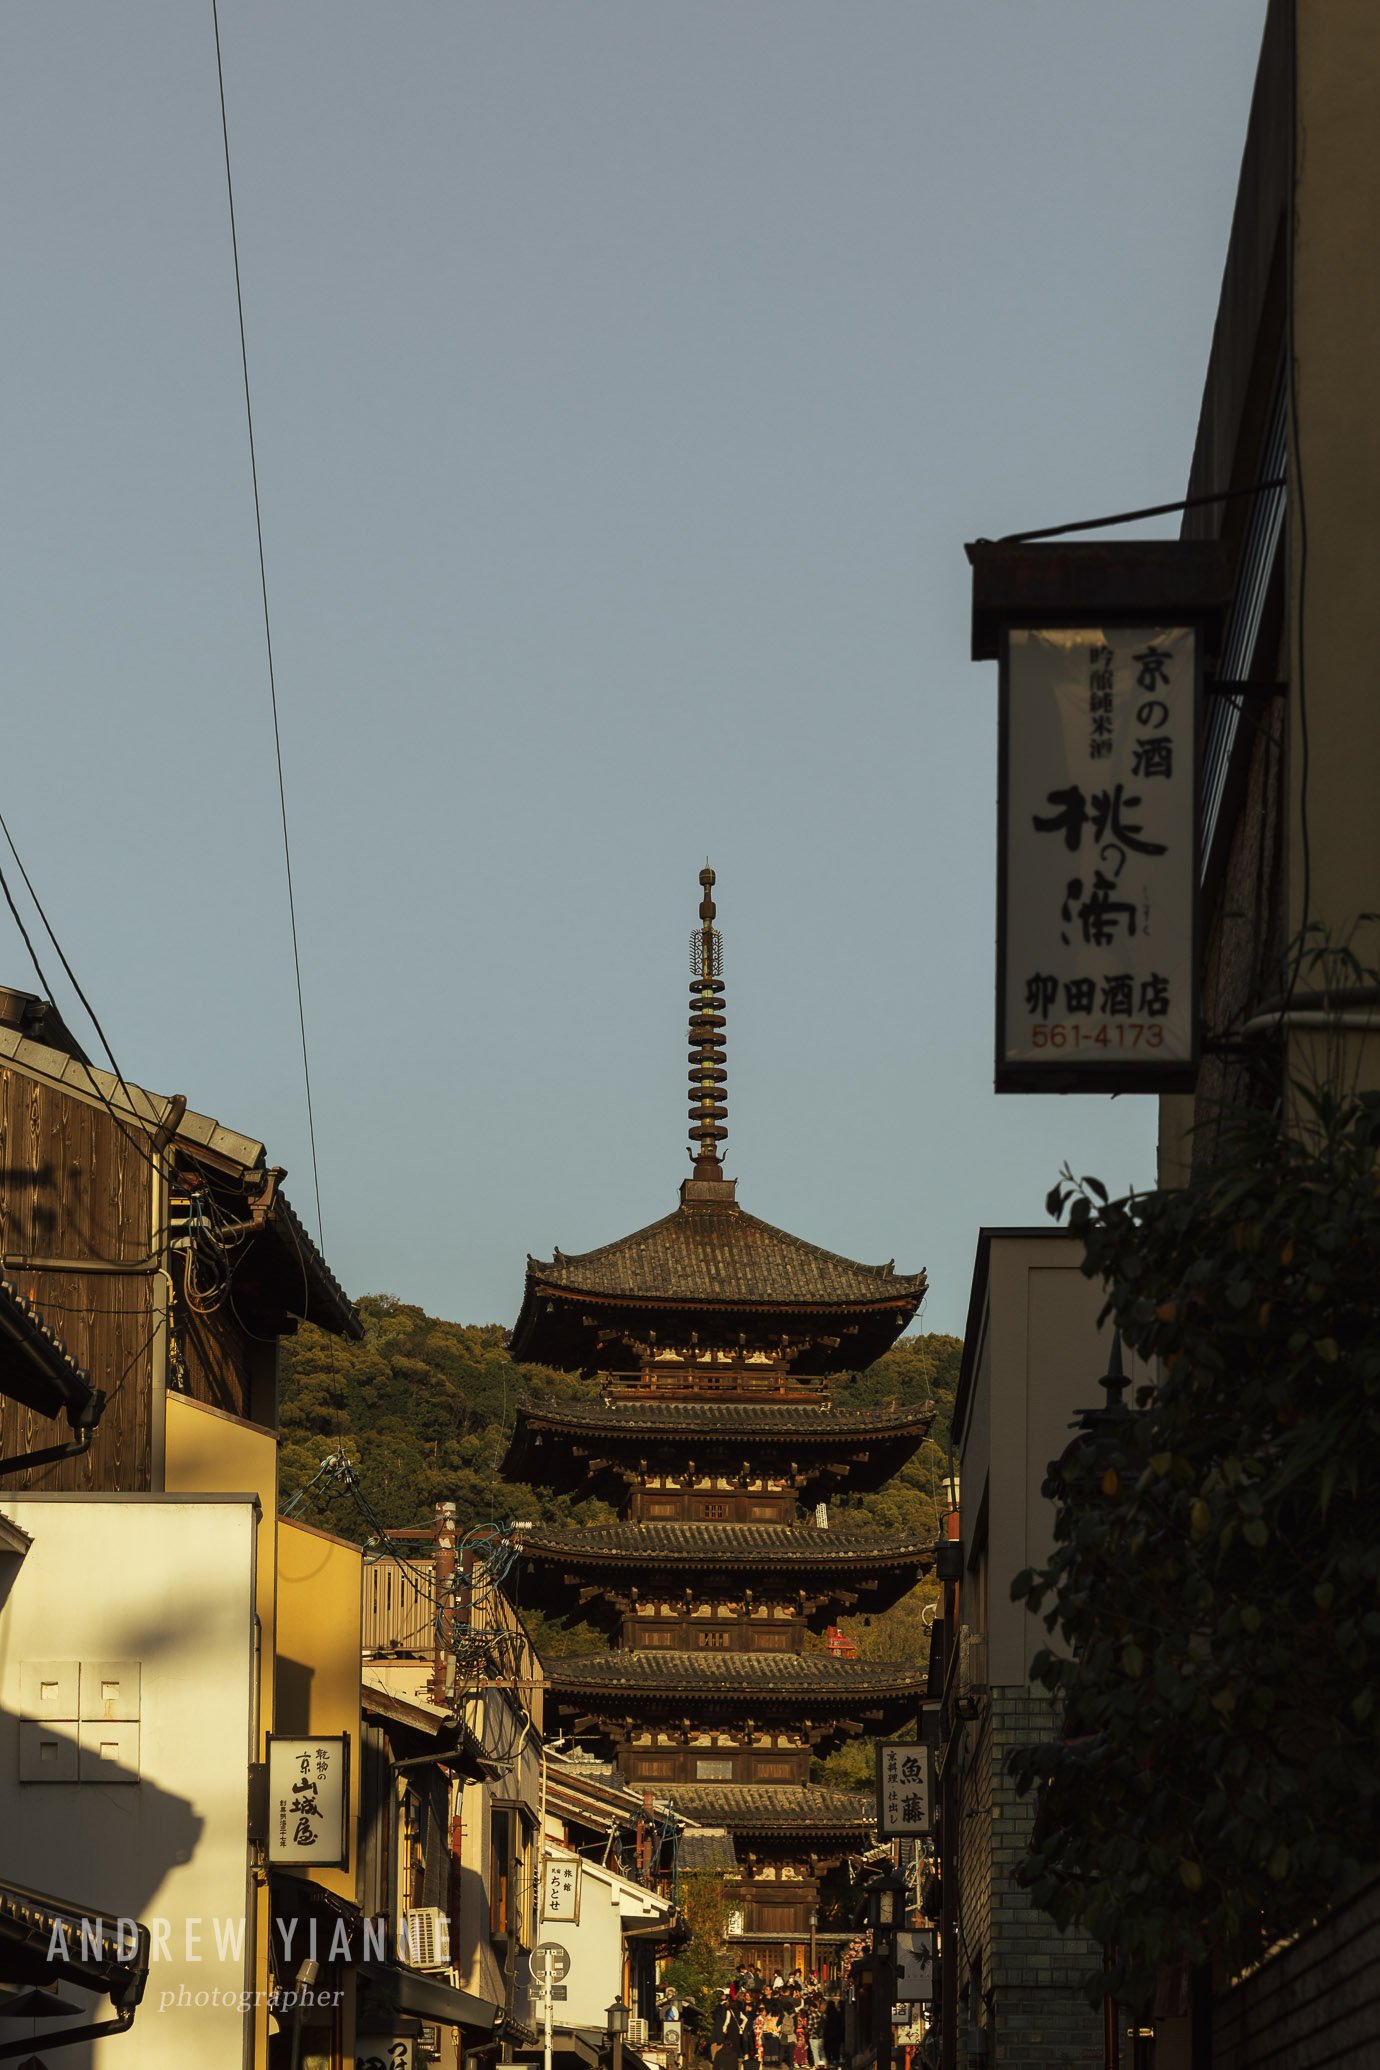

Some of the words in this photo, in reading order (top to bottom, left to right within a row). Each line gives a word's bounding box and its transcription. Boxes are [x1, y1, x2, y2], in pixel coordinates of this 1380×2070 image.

[1131, 646, 1173, 778] 京の酒
[1026, 972, 1169, 1021] 卯田酒店
[1032, 1024, 1164, 1048] 561-4173
[315, 1748, 330, 1780] 乾物の
[899, 1756, 925, 1823] 魚藤
[550, 1876, 560, 1911] ちとせ
[563, 1869, 573, 1892] 旅館
